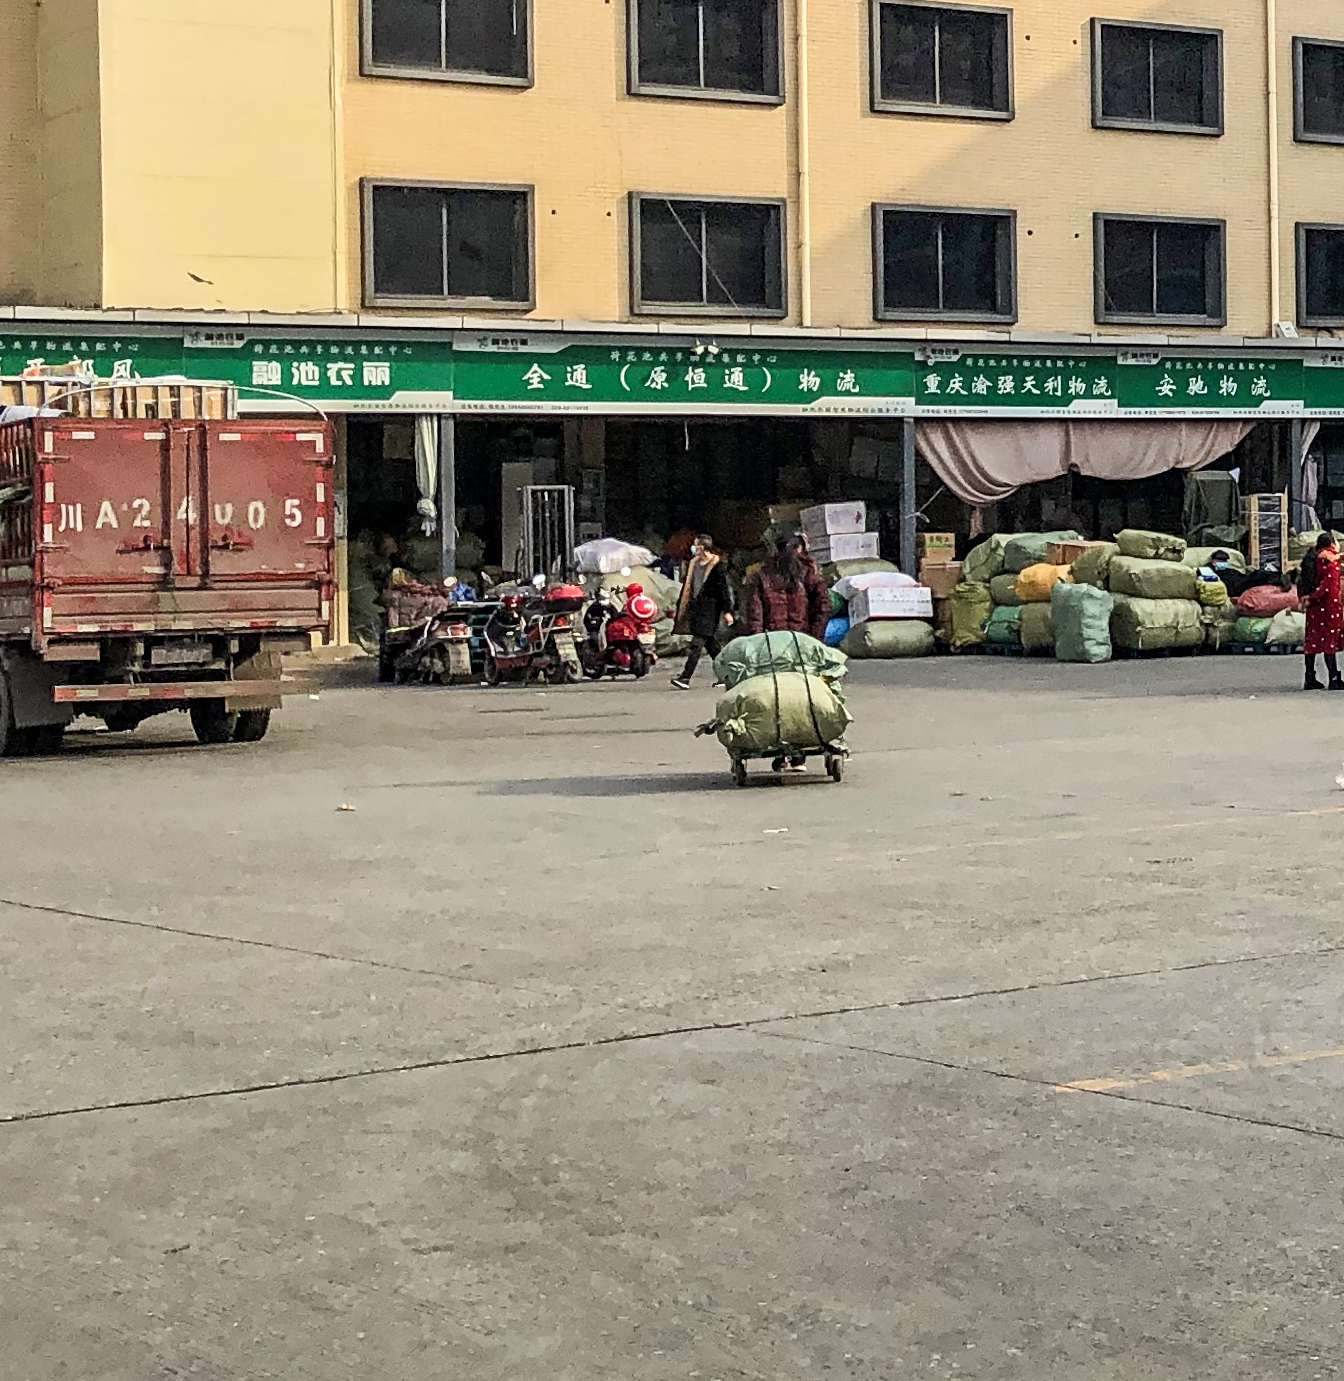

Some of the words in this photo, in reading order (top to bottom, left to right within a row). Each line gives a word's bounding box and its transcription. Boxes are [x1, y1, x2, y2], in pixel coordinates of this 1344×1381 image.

[252, 360, 391, 386] 融池衣丽
[521, 363, 860, 393] 全通(原恒通)物流
[923, 373, 1112, 397] 重庆渝强天利物流
[1155, 374, 1271, 397] 安驰物流
